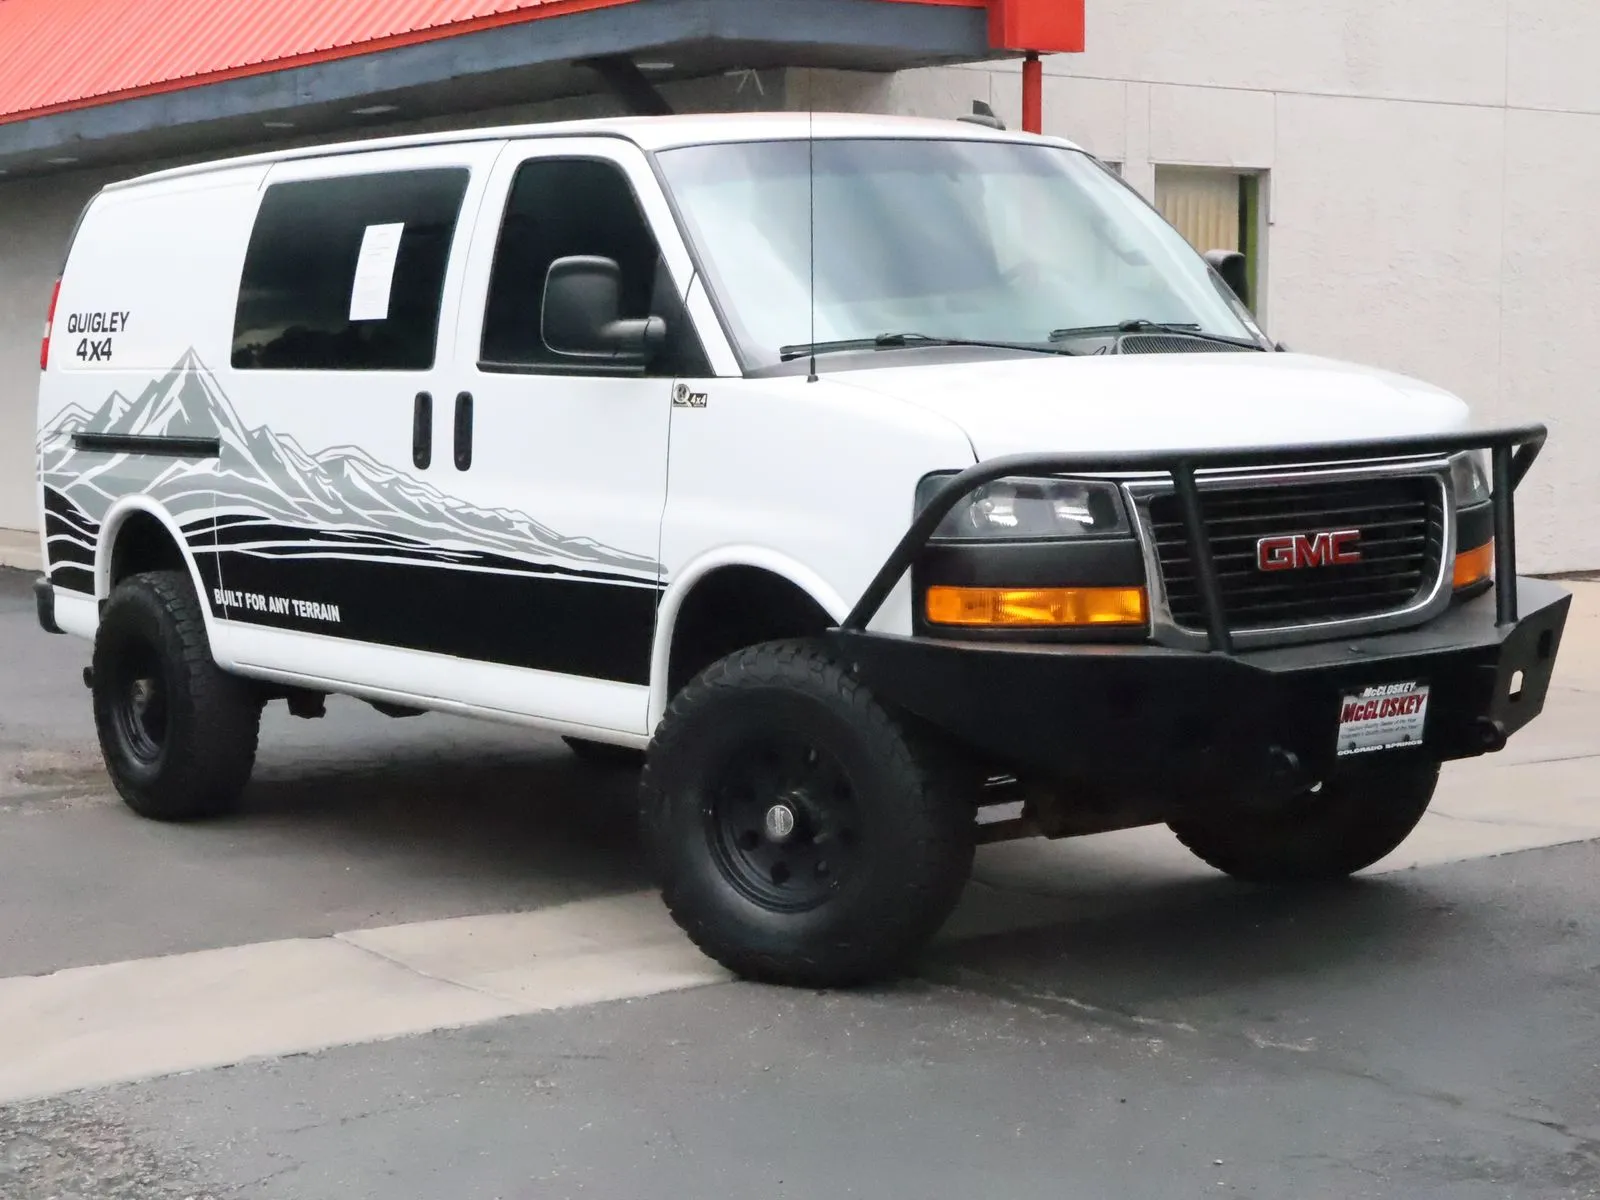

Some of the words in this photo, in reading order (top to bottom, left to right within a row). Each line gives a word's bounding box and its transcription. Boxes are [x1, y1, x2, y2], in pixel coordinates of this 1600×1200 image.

[68, 311, 130, 333] QUIGLEY
[1257, 529, 1361, 571] GMC
[214, 588, 243, 608] BUILT
[245, 592, 267, 612] FOR
[269, 596, 290, 615] ANY
[291, 599, 341, 622] TERRAIN
[1363, 682, 1416, 698] McCLOSKEY
[1340, 694, 1427, 724] McCLOSKEY
[1337, 744, 1383, 756] COLORADO
[1385, 739, 1423, 749] SPRINGS
